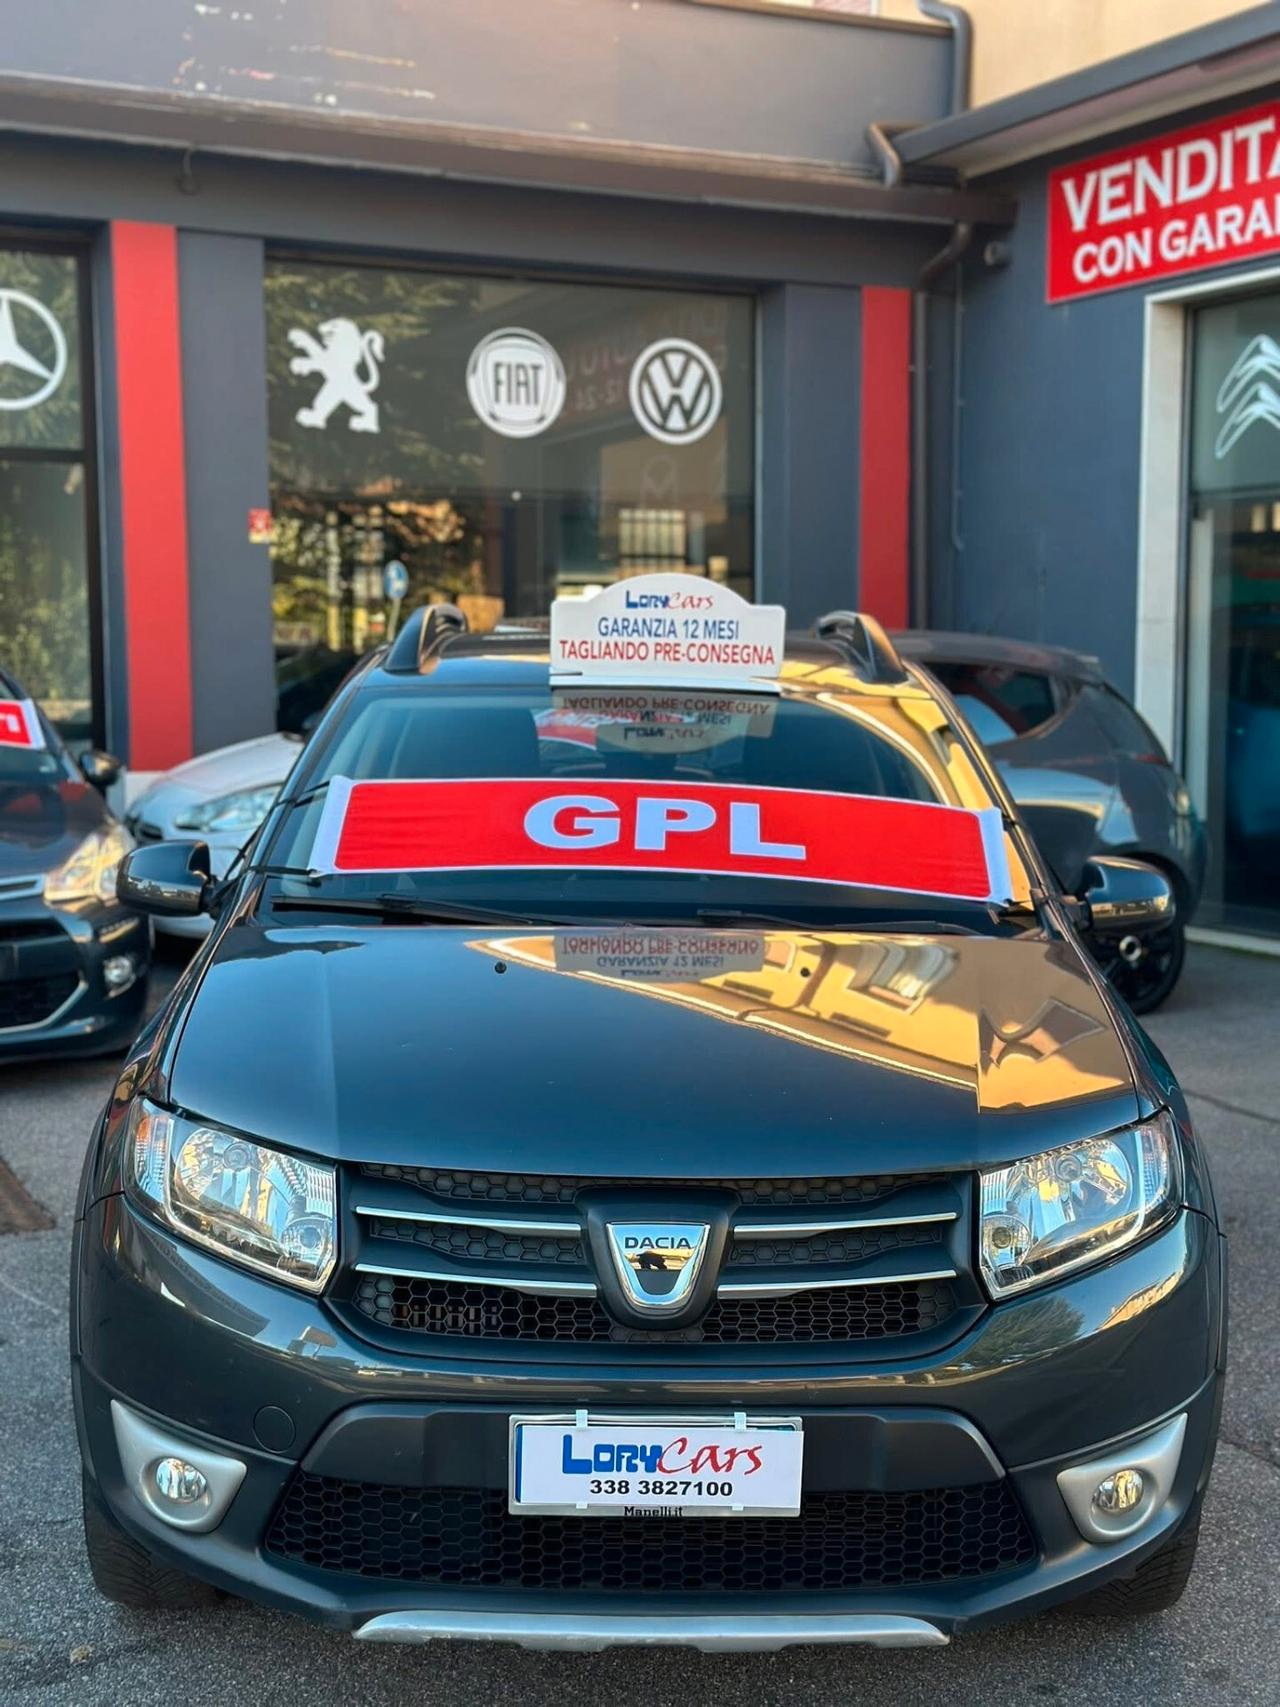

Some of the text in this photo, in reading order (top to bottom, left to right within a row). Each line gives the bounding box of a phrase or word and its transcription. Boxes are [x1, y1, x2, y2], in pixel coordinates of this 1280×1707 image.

[1061, 115, 1280, 232] VENDIT
[1072, 194, 1280, 284] CON GARA
[493, 362, 543, 405] FIAT
[598, 617, 739, 639] GARANZIA 12 MESI
[559, 640, 775, 665] TAGLIANDO PRE-CONSEGNA
[524, 795, 806, 860] GPL
[624, 1237, 691, 1249] DACIA
[590, 1480, 733, 1496] 338 3827100
[624, 1505, 682, 1517] Manelli.it
